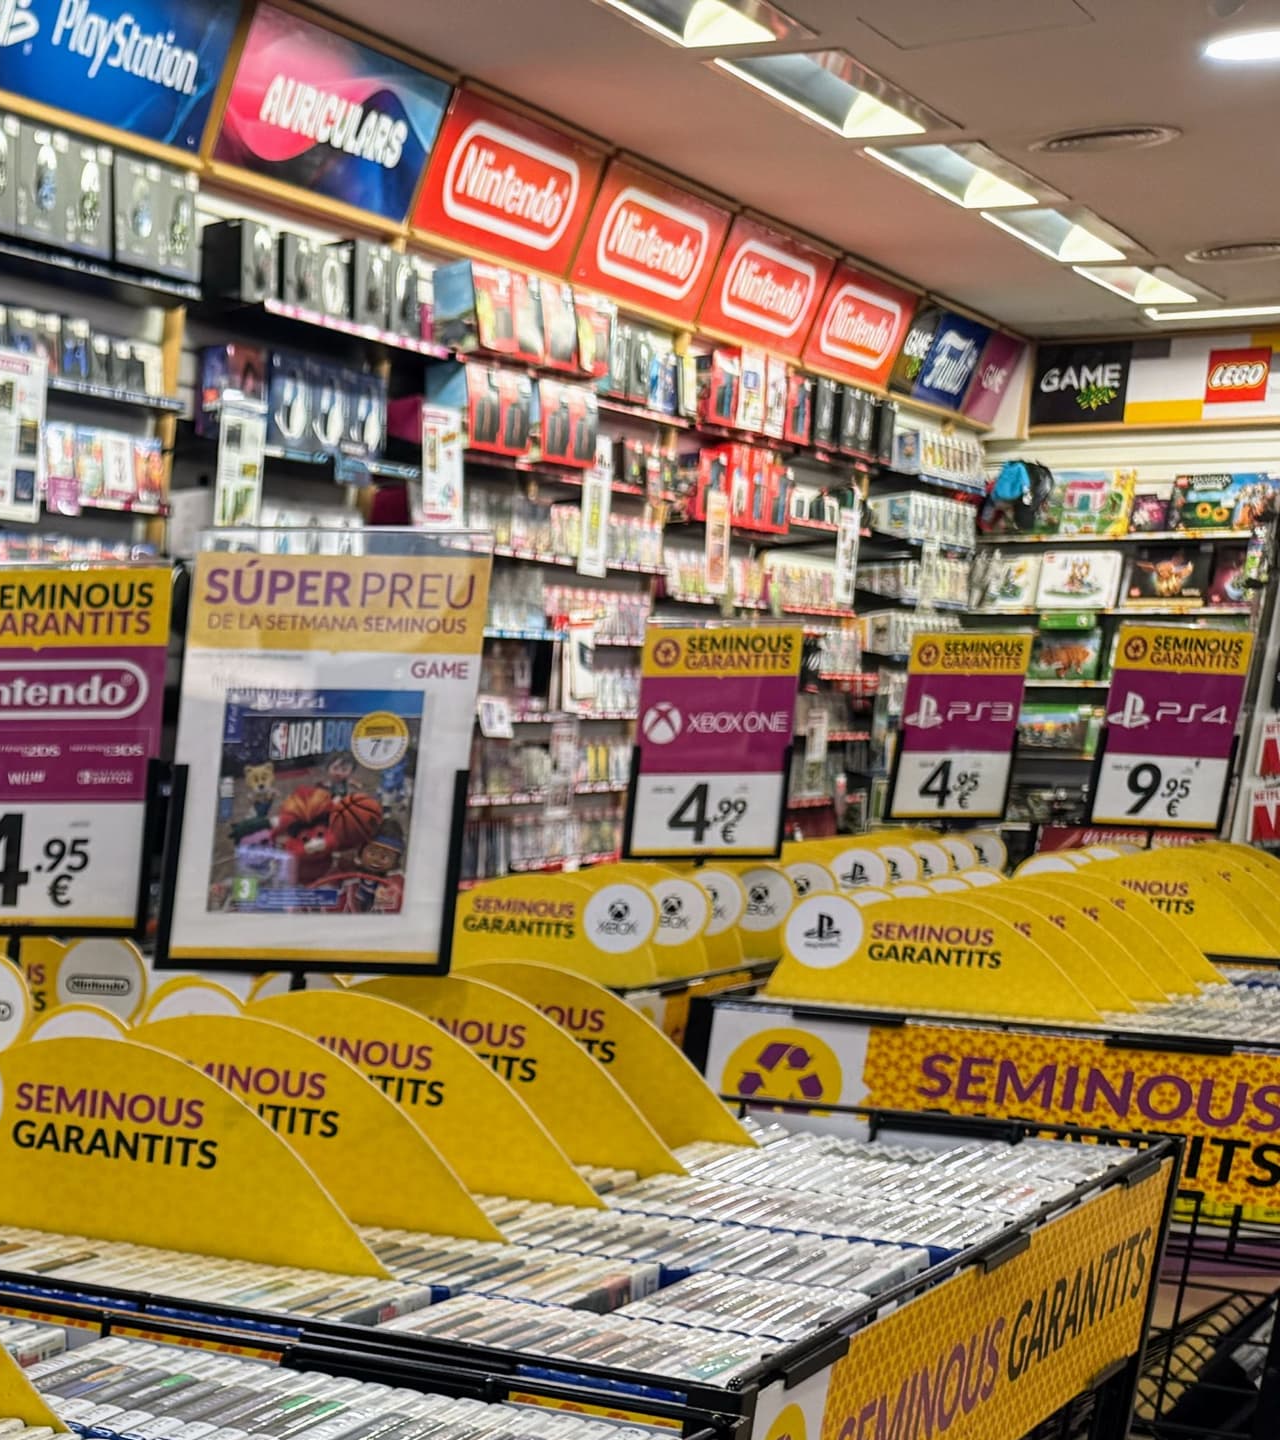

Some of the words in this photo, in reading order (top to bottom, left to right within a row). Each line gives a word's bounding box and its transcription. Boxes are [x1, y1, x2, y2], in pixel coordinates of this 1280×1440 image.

[52, 2, 198, 95] PlayStation
[259, 75, 407, 169] AURICULARS
[456, 144, 565, 228] Nintendo
[607, 207, 695, 281] Nintendo
[731, 260, 804, 316] Nintendo
[833, 301, 890, 354] Nintendo
[1040, 364, 1122, 392] GAME
[1210, 362, 1267, 389] LEGO
[207, 614, 234, 631] DE
[239, 614, 264, 631] LA
[267, 615, 358, 633] SETMANA
[362, 617, 467, 636] SEMINOUS
[686, 635, 793, 655] SEMINOUS
[1150, 634, 1243, 656] SEMINOUS
[411, 661, 469, 681] GAME
[684, 653, 791, 670] GARANTITS
[1149, 650, 1240, 670] GARANTITS
[686, 712, 741, 733] XBOX
[743, 713, 788, 733] ONE
[1157, 703, 1228, 724] PS4
[286, 721, 324, 755] NBA
[472, 896, 575, 921] SEMINOUS
[462, 915, 576, 939] GARANTITS
[871, 921, 994, 947] SEMINOUS
[868, 943, 1001, 970] GARANTITS
[918, 1053, 1280, 1131] SEMINOUS
[15, 1083, 205, 1130] SEMINOUS
[12, 1119, 218, 1171] GARANTITS
[1006, 1228, 1151, 1381] GARANTITS
